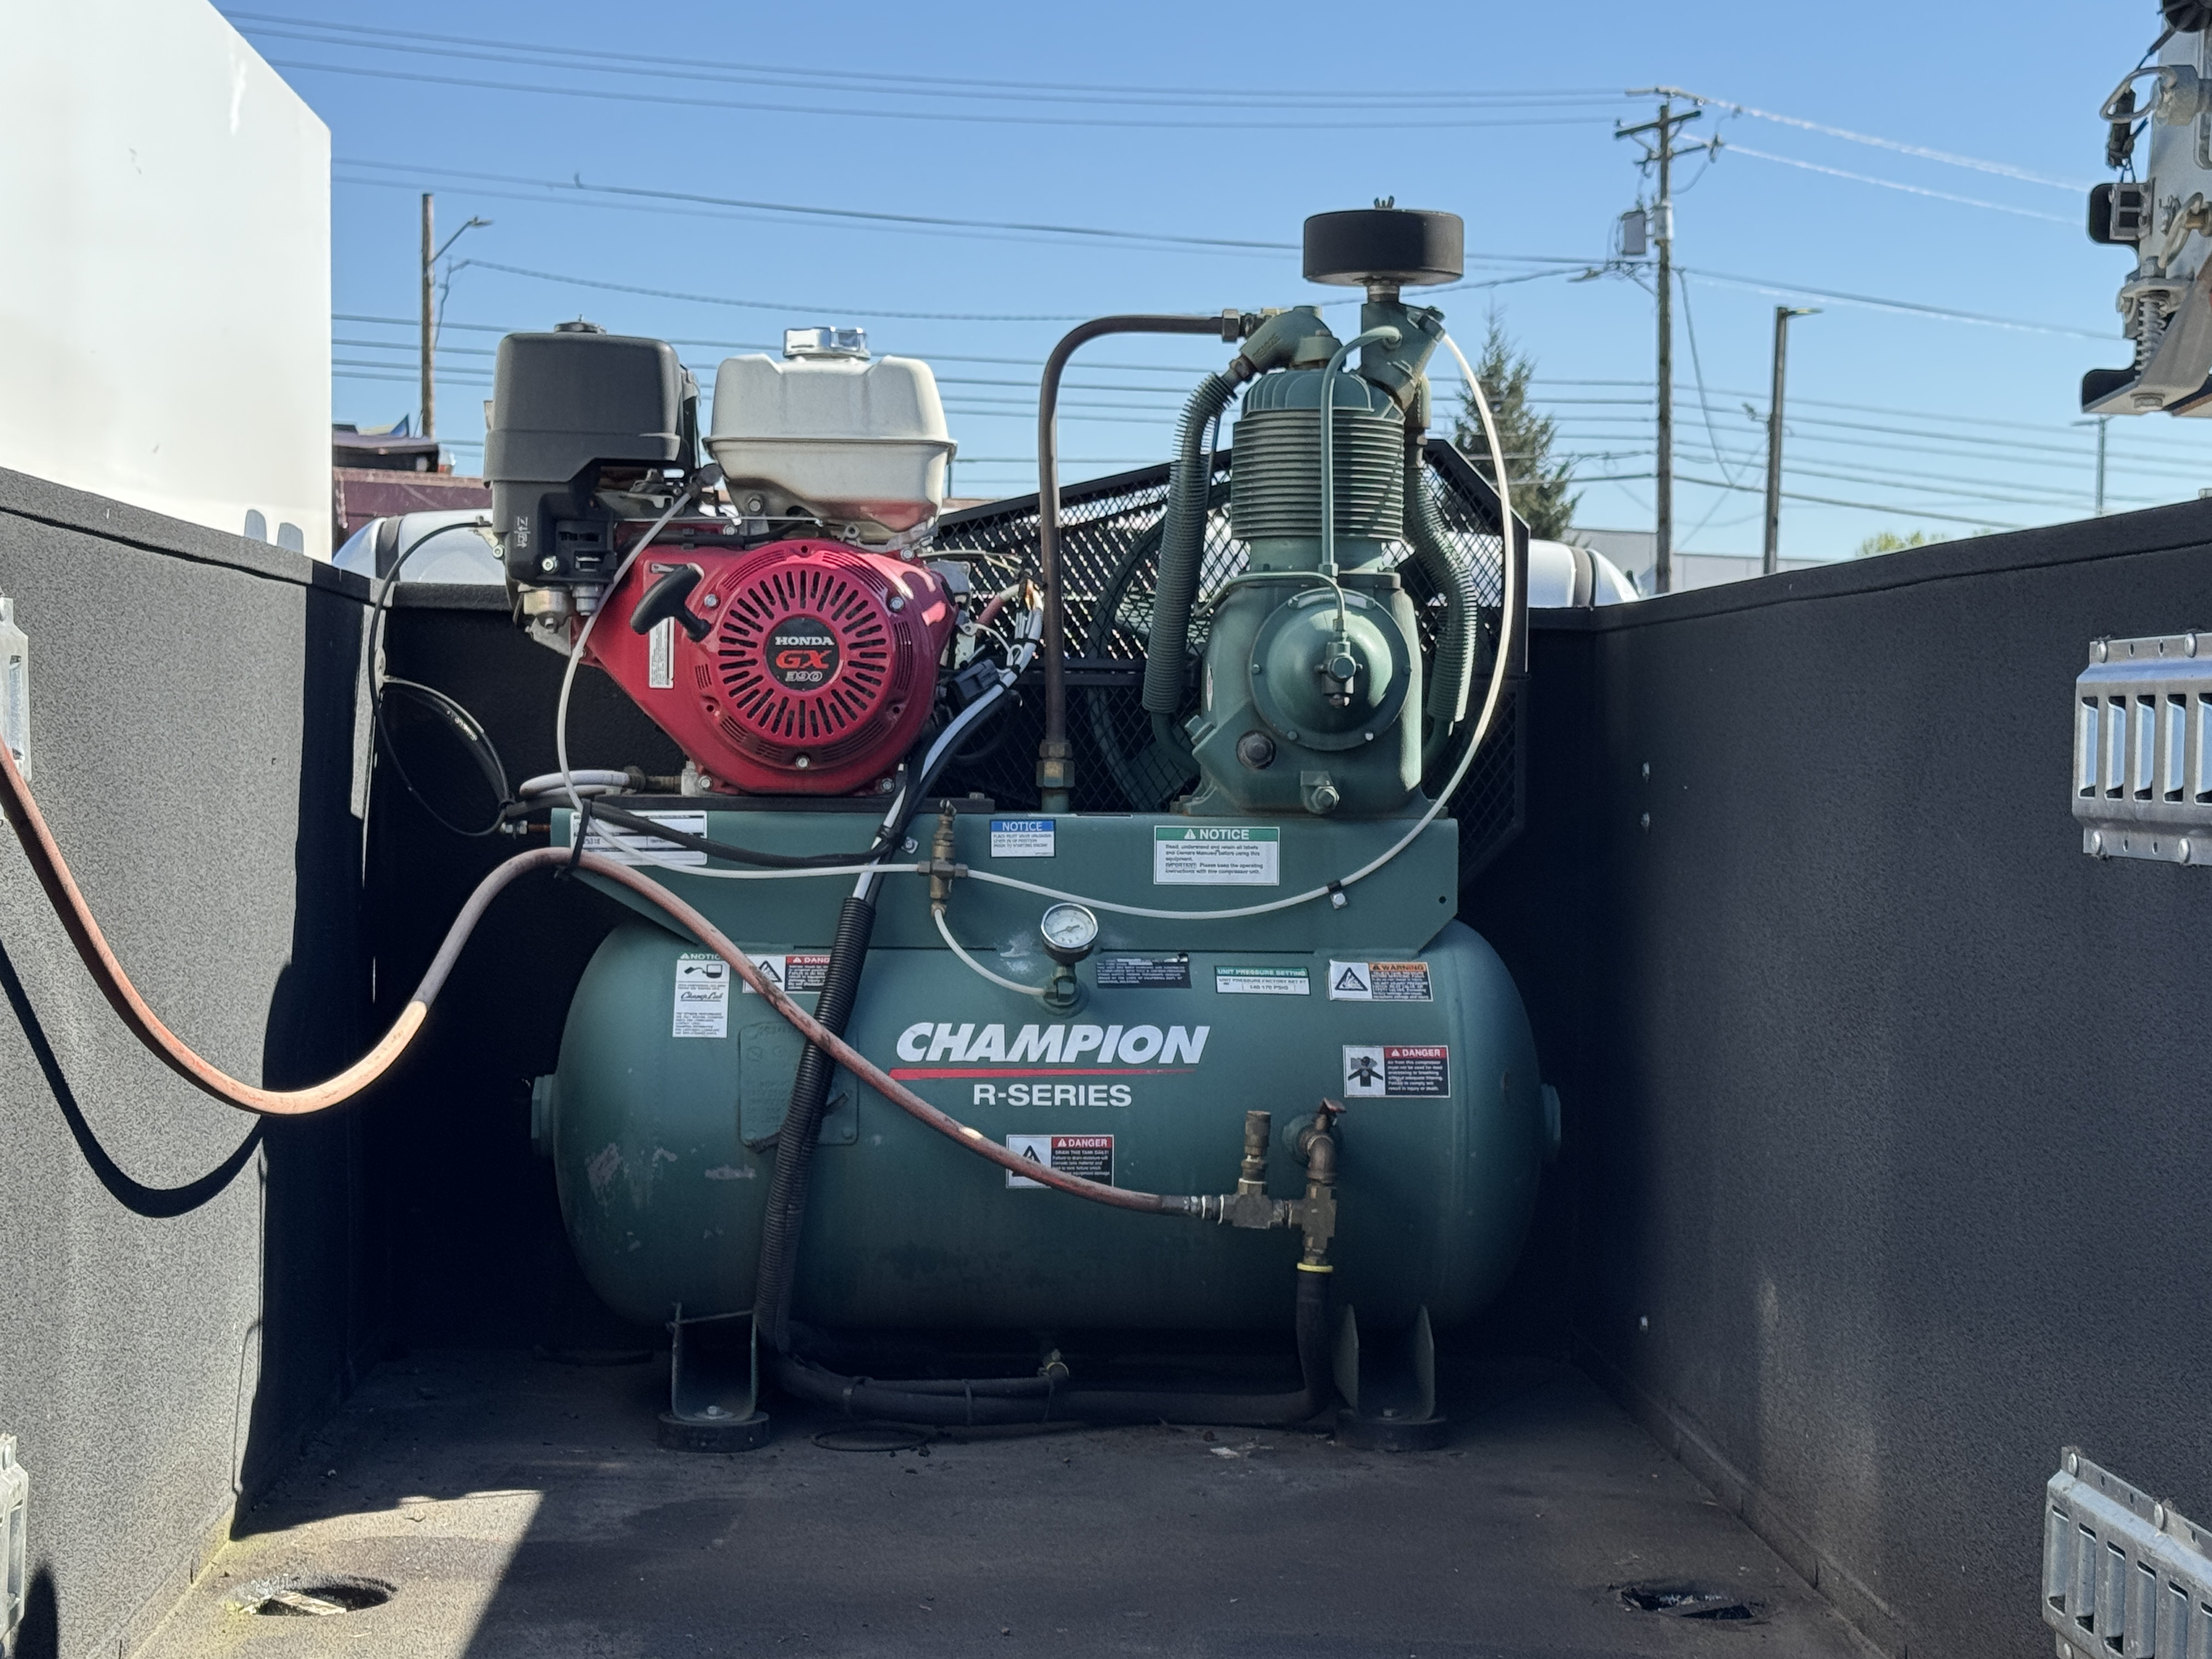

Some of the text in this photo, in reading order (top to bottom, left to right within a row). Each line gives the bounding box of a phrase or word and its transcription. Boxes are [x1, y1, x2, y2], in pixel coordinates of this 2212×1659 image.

[775, 636, 834, 645] HONDA
[776, 650, 832, 669] GX
[1002, 821, 1043, 831] NOTICE
[1200, 829, 1250, 840] NOTICE
[896, 1022, 1210, 1064] CHAMPION
[1402, 1048, 1441, 1057] DANGER
[973, 1084, 1132, 1107] R-SERIES
[1068, 1138, 1108, 1147] DANGER
